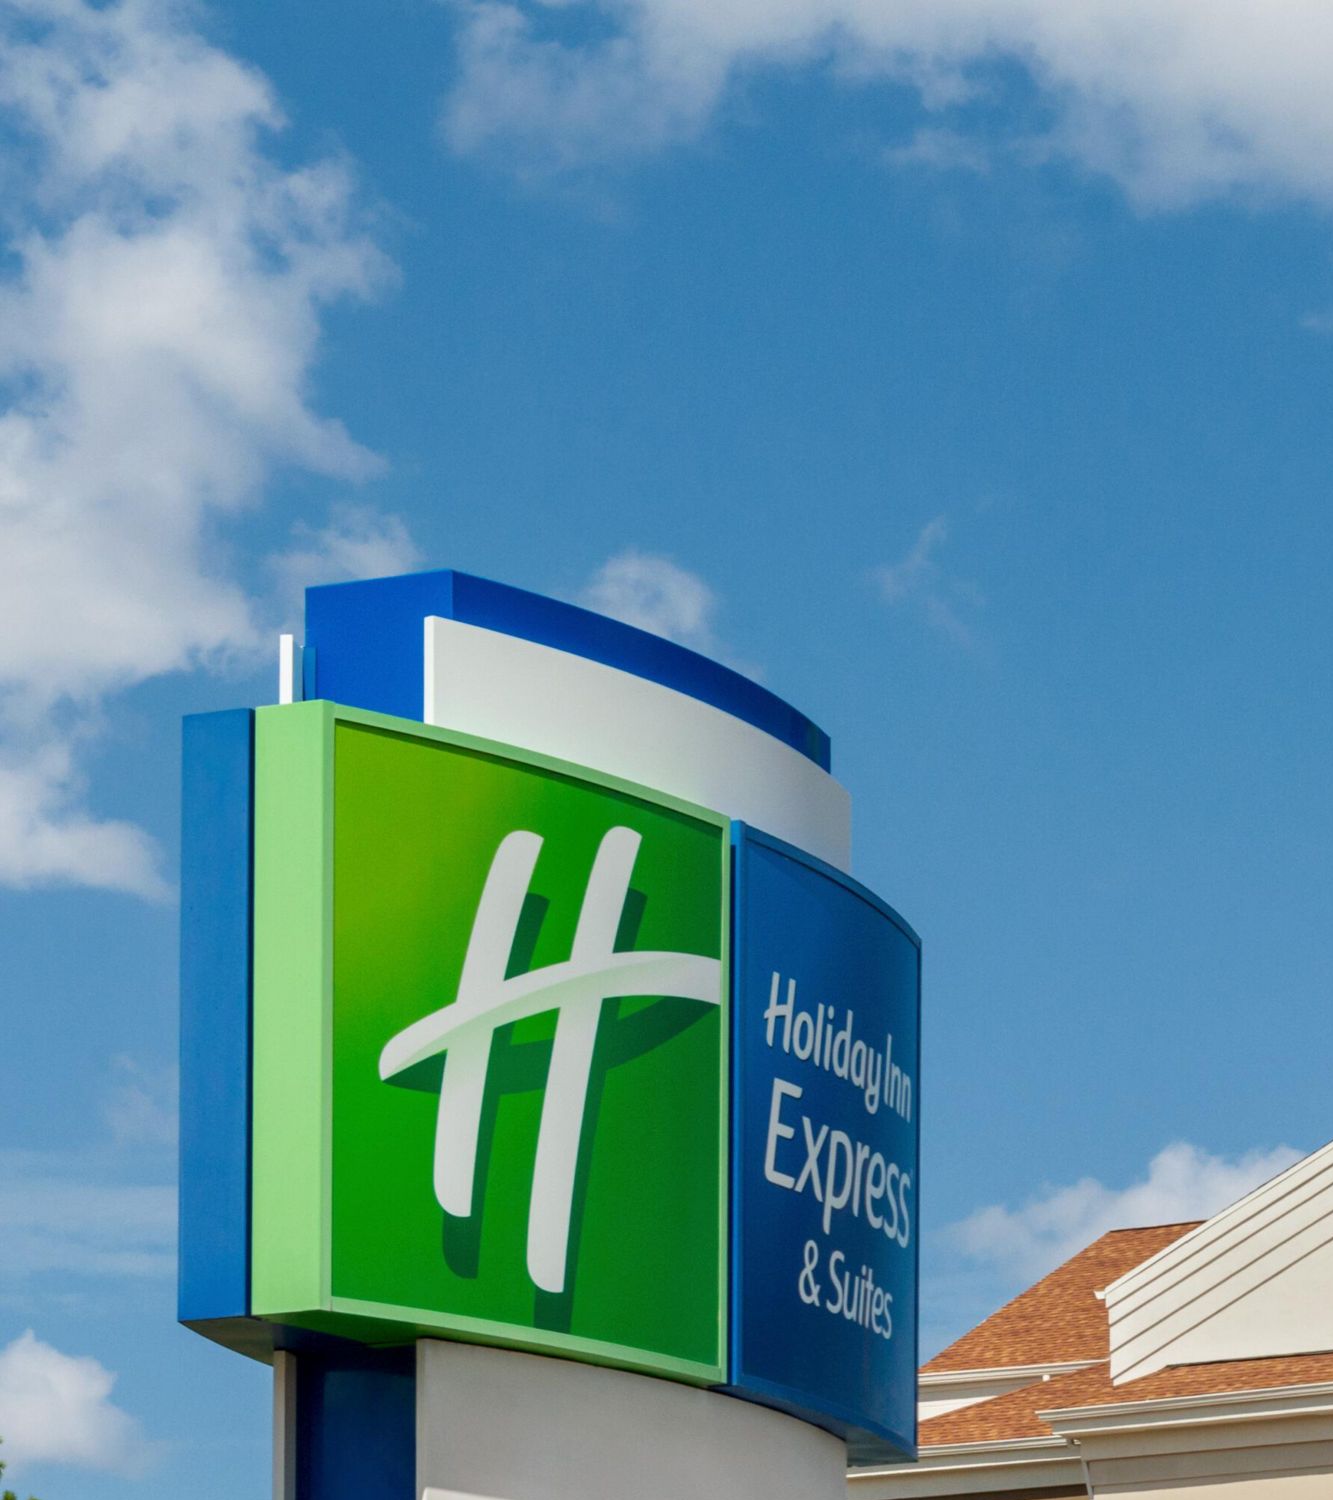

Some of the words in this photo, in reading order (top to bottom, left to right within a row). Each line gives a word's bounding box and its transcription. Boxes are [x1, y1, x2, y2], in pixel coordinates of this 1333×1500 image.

[763, 971, 882, 1115] Holiday
[884, 1032, 912, 1124] Inn
[763, 1077, 912, 1249] Express
[799, 1239, 820, 1305] &
[827, 1250, 893, 1340] Suites
